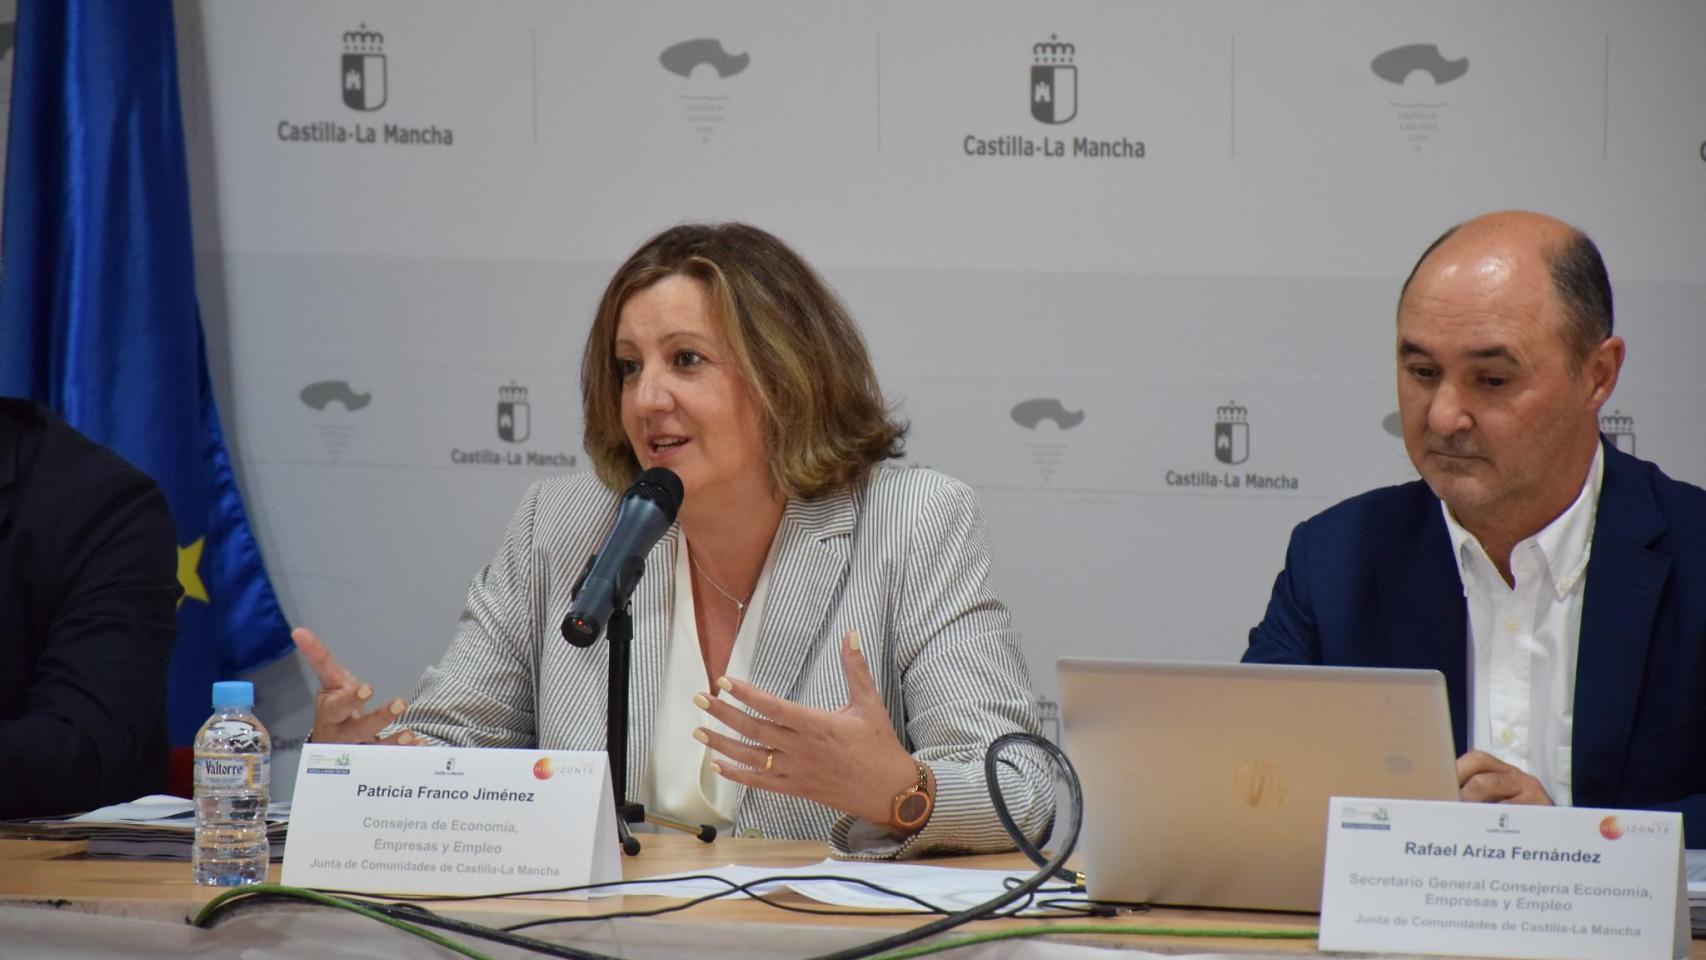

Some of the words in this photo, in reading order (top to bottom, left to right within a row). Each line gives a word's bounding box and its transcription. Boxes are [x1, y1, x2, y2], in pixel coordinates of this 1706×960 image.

[277, 120, 376, 144] Castilla-La
[384, 123, 453, 146] Mancha
[963, 134, 1064, 157] Castilla-La
[1073, 136, 1146, 158] Mancha
[452, 448, 522, 465] Castilla-La
[527, 450, 576, 467] Mancha
[1166, 470, 1240, 488] Castilla-La
[1246, 473, 1299, 490] Mancha
[205, 760, 242, 775] Valtorre
[357, 784, 413, 799] Patricia
[417, 786, 469, 801] Franco
[473, 787, 535, 803] Jiménez
[362, 816, 428, 832] Consejera
[431, 819, 448, 831] de
[374, 838, 438, 853] Empresas
[441, 842, 450, 855] y
[453, 840, 502, 856] Empleo
[1405, 841, 1457, 857] Rafael
[1462, 844, 1506, 860] Ariza
[1511, 846, 1601, 864] Fernández
[310, 858, 341, 870] Junta
[344, 859, 358, 870] de
[361, 859, 436, 872] Comunidades
[439, 862, 453, 873] de
[456, 863, 514, 875] Castilla-La
[517, 865, 560, 877] Mancha
[1350, 872, 1424, 888] Secretario
[1428, 876, 1485, 891] General
[1425, 893, 1498, 909] Empresas
[1503, 899, 1512, 911] y
[1516, 897, 1573, 913] Empleo
[1355, 914, 1389, 925] Junta
[1393, 915, 1408, 926] de
[1412, 915, 1498, 930] Comunidades
[1501, 920, 1517, 931] de
[1521, 921, 1587, 935] Castilla-La
[1591, 924, 1642, 938] Mancha
